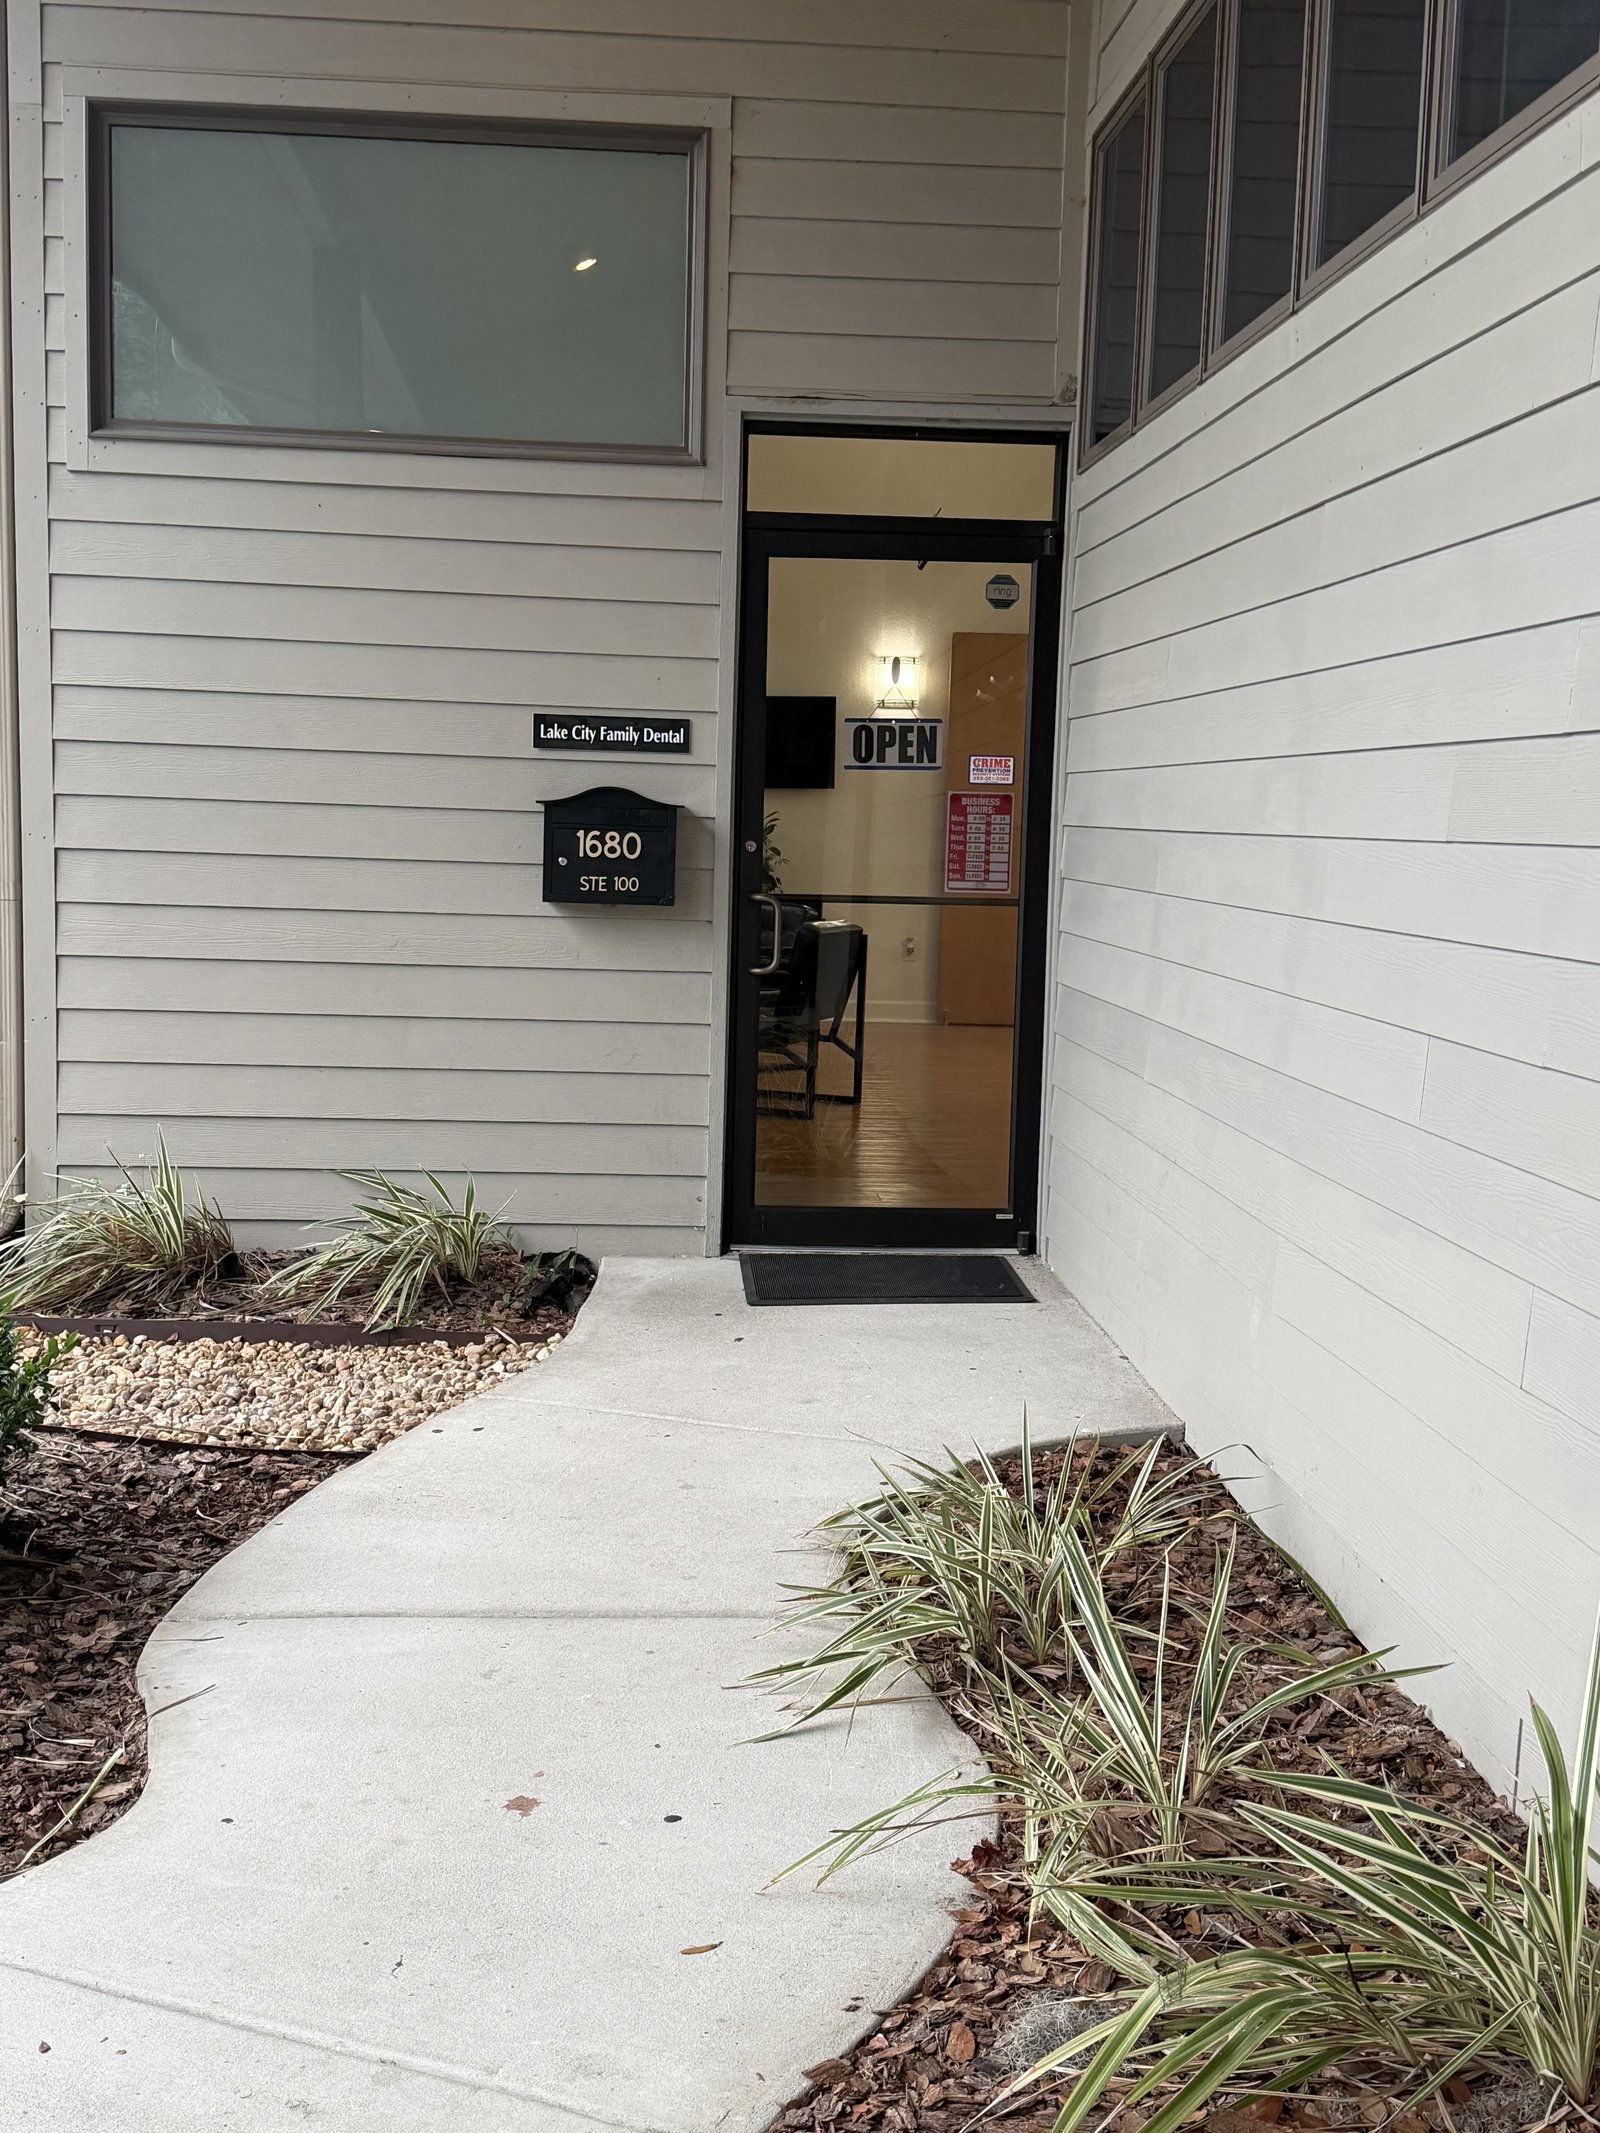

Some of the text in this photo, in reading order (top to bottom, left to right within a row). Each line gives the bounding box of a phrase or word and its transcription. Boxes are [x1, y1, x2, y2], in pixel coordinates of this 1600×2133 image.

[994, 586, 1012, 598] ring
[540, 723, 684, 745] Lake City Family Dental
[853, 724, 938, 764] OPEN
[972, 758, 1011, 768] CRIME
[961, 797, 1001, 806] BUSINESS
[966, 805, 996, 814] HOURS:
[576, 829, 642, 860] 1680
[949, 852, 960, 860] Fri.
[948, 862, 961, 870] Sat.
[948, 872, 963, 880] Sun.
[579, 876, 640, 892] STE 100
